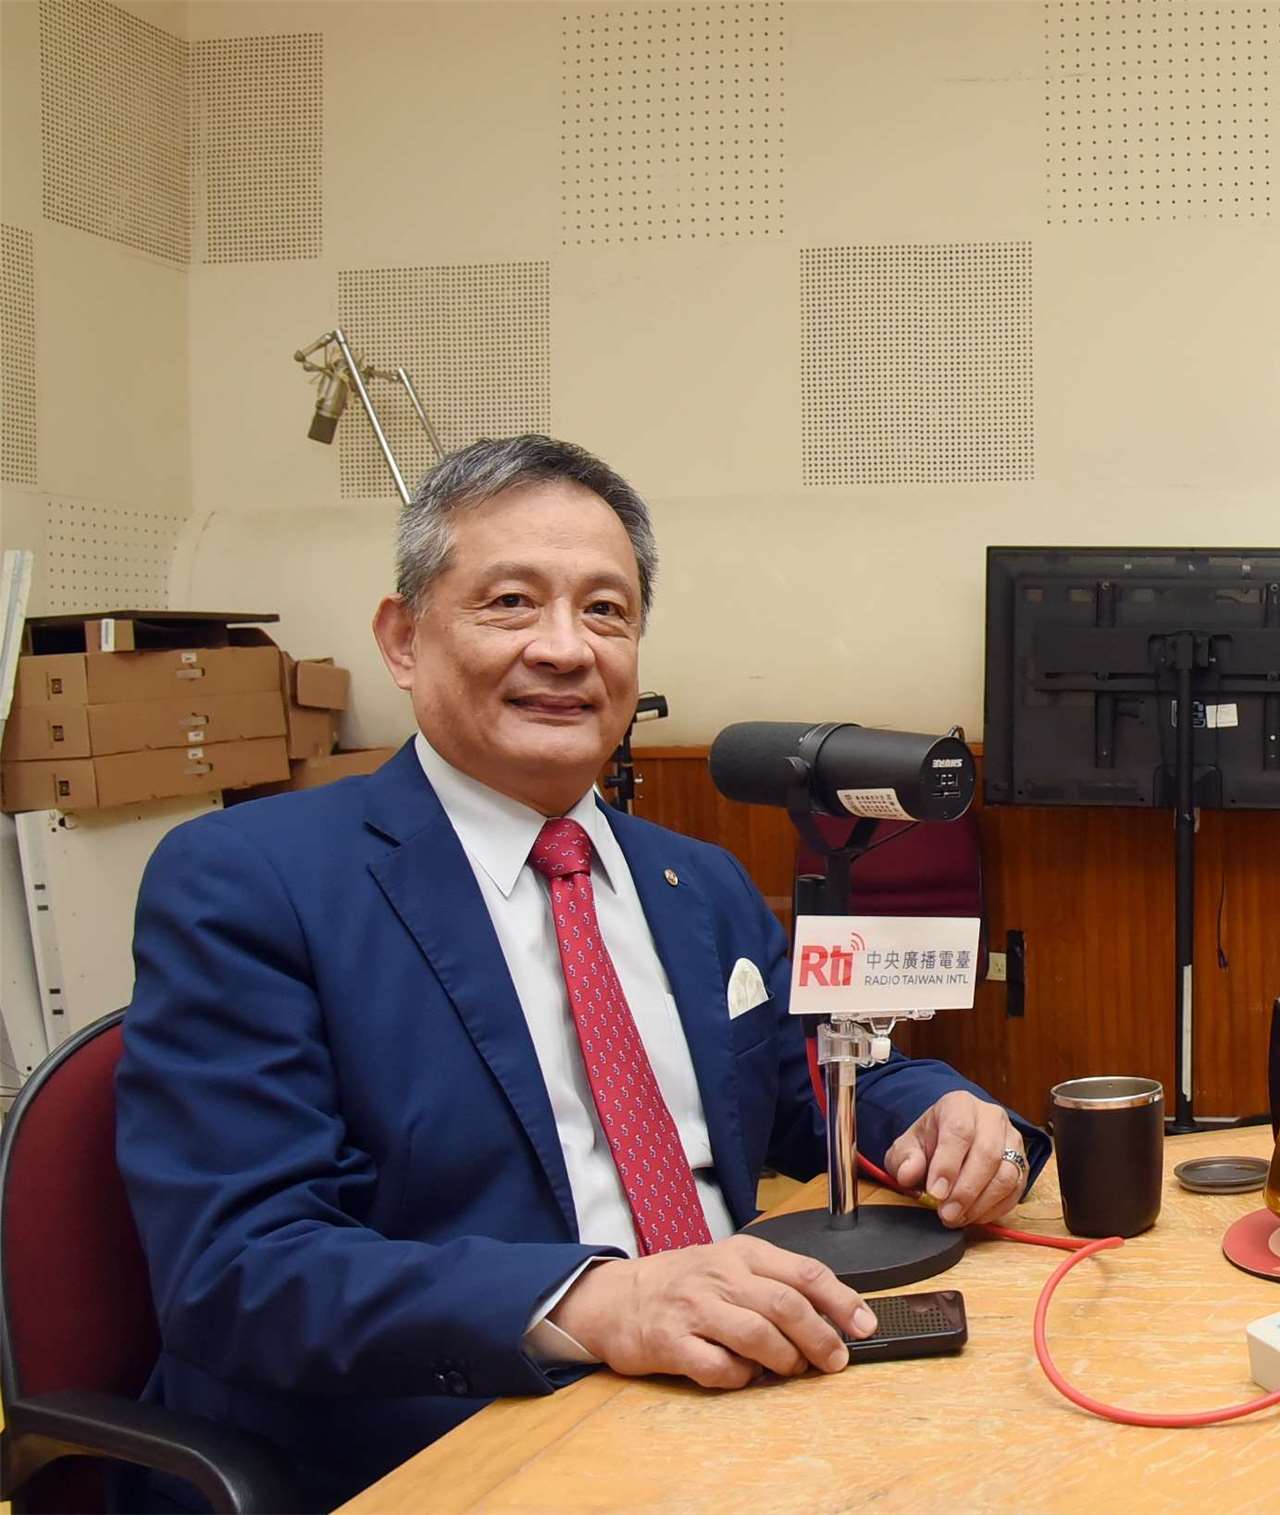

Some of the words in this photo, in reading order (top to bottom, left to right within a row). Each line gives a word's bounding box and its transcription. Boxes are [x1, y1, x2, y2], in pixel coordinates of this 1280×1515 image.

[798, 945, 854, 987] Rti
[866, 950, 972, 970] 中央廣播電臺
[864, 975, 900, 986] RADIO
[902, 974, 944, 985] TAIWAN
[945, 974, 969, 984] INTL
